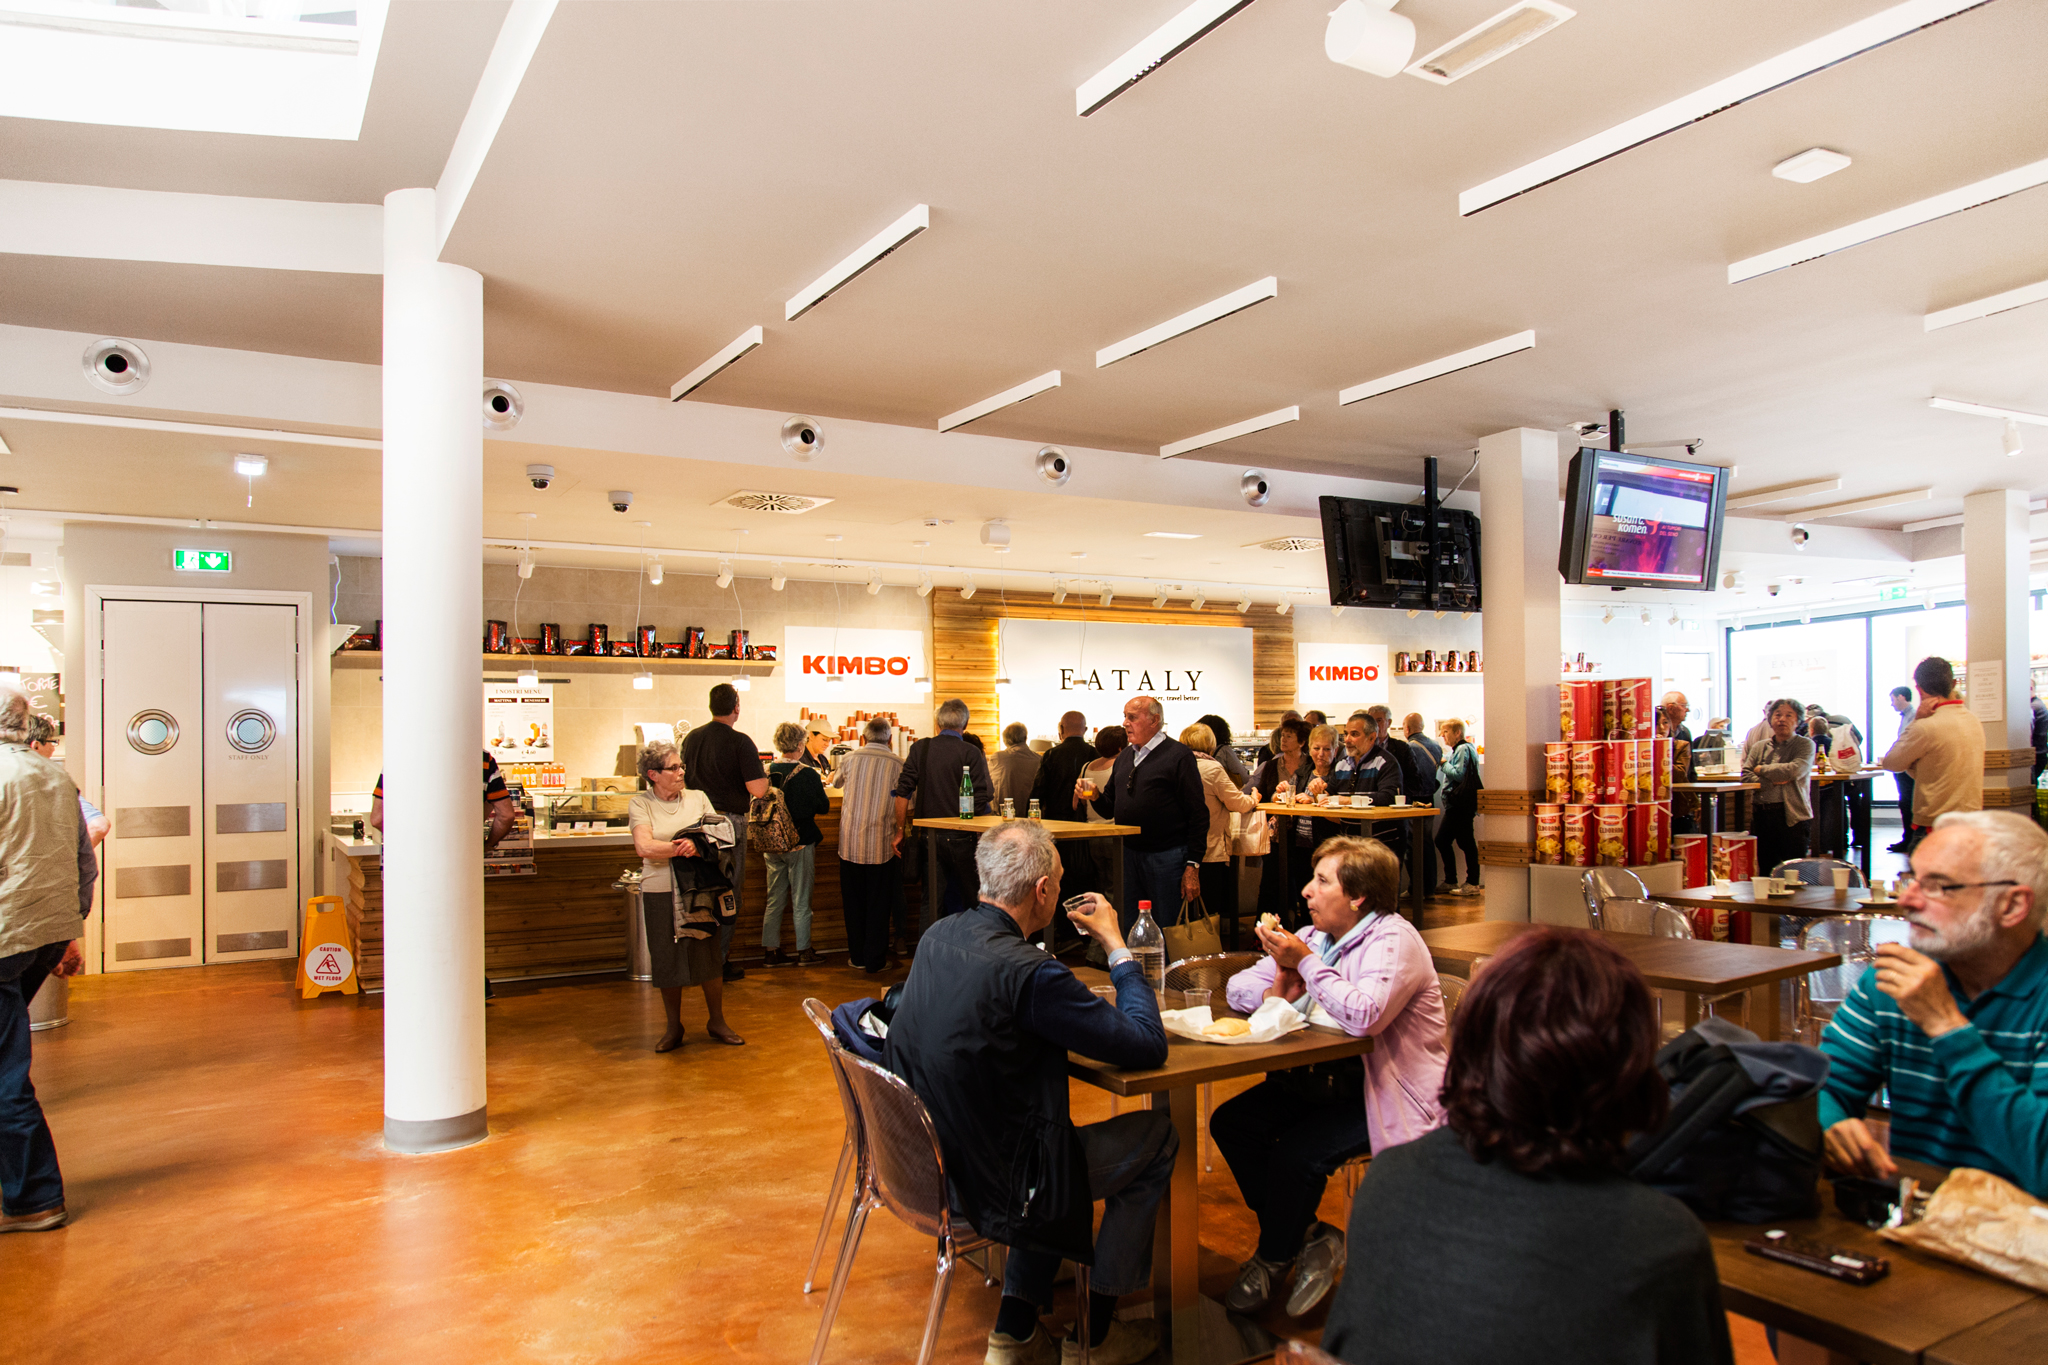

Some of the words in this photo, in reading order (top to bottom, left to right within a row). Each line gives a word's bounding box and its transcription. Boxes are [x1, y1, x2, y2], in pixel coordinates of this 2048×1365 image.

[803, 655, 909, 676] KIMBO
[1309, 665, 1379, 681] KIMBO
[20, 676, 59, 692] TORTE
[1059, 668, 1203, 691] EATALY
